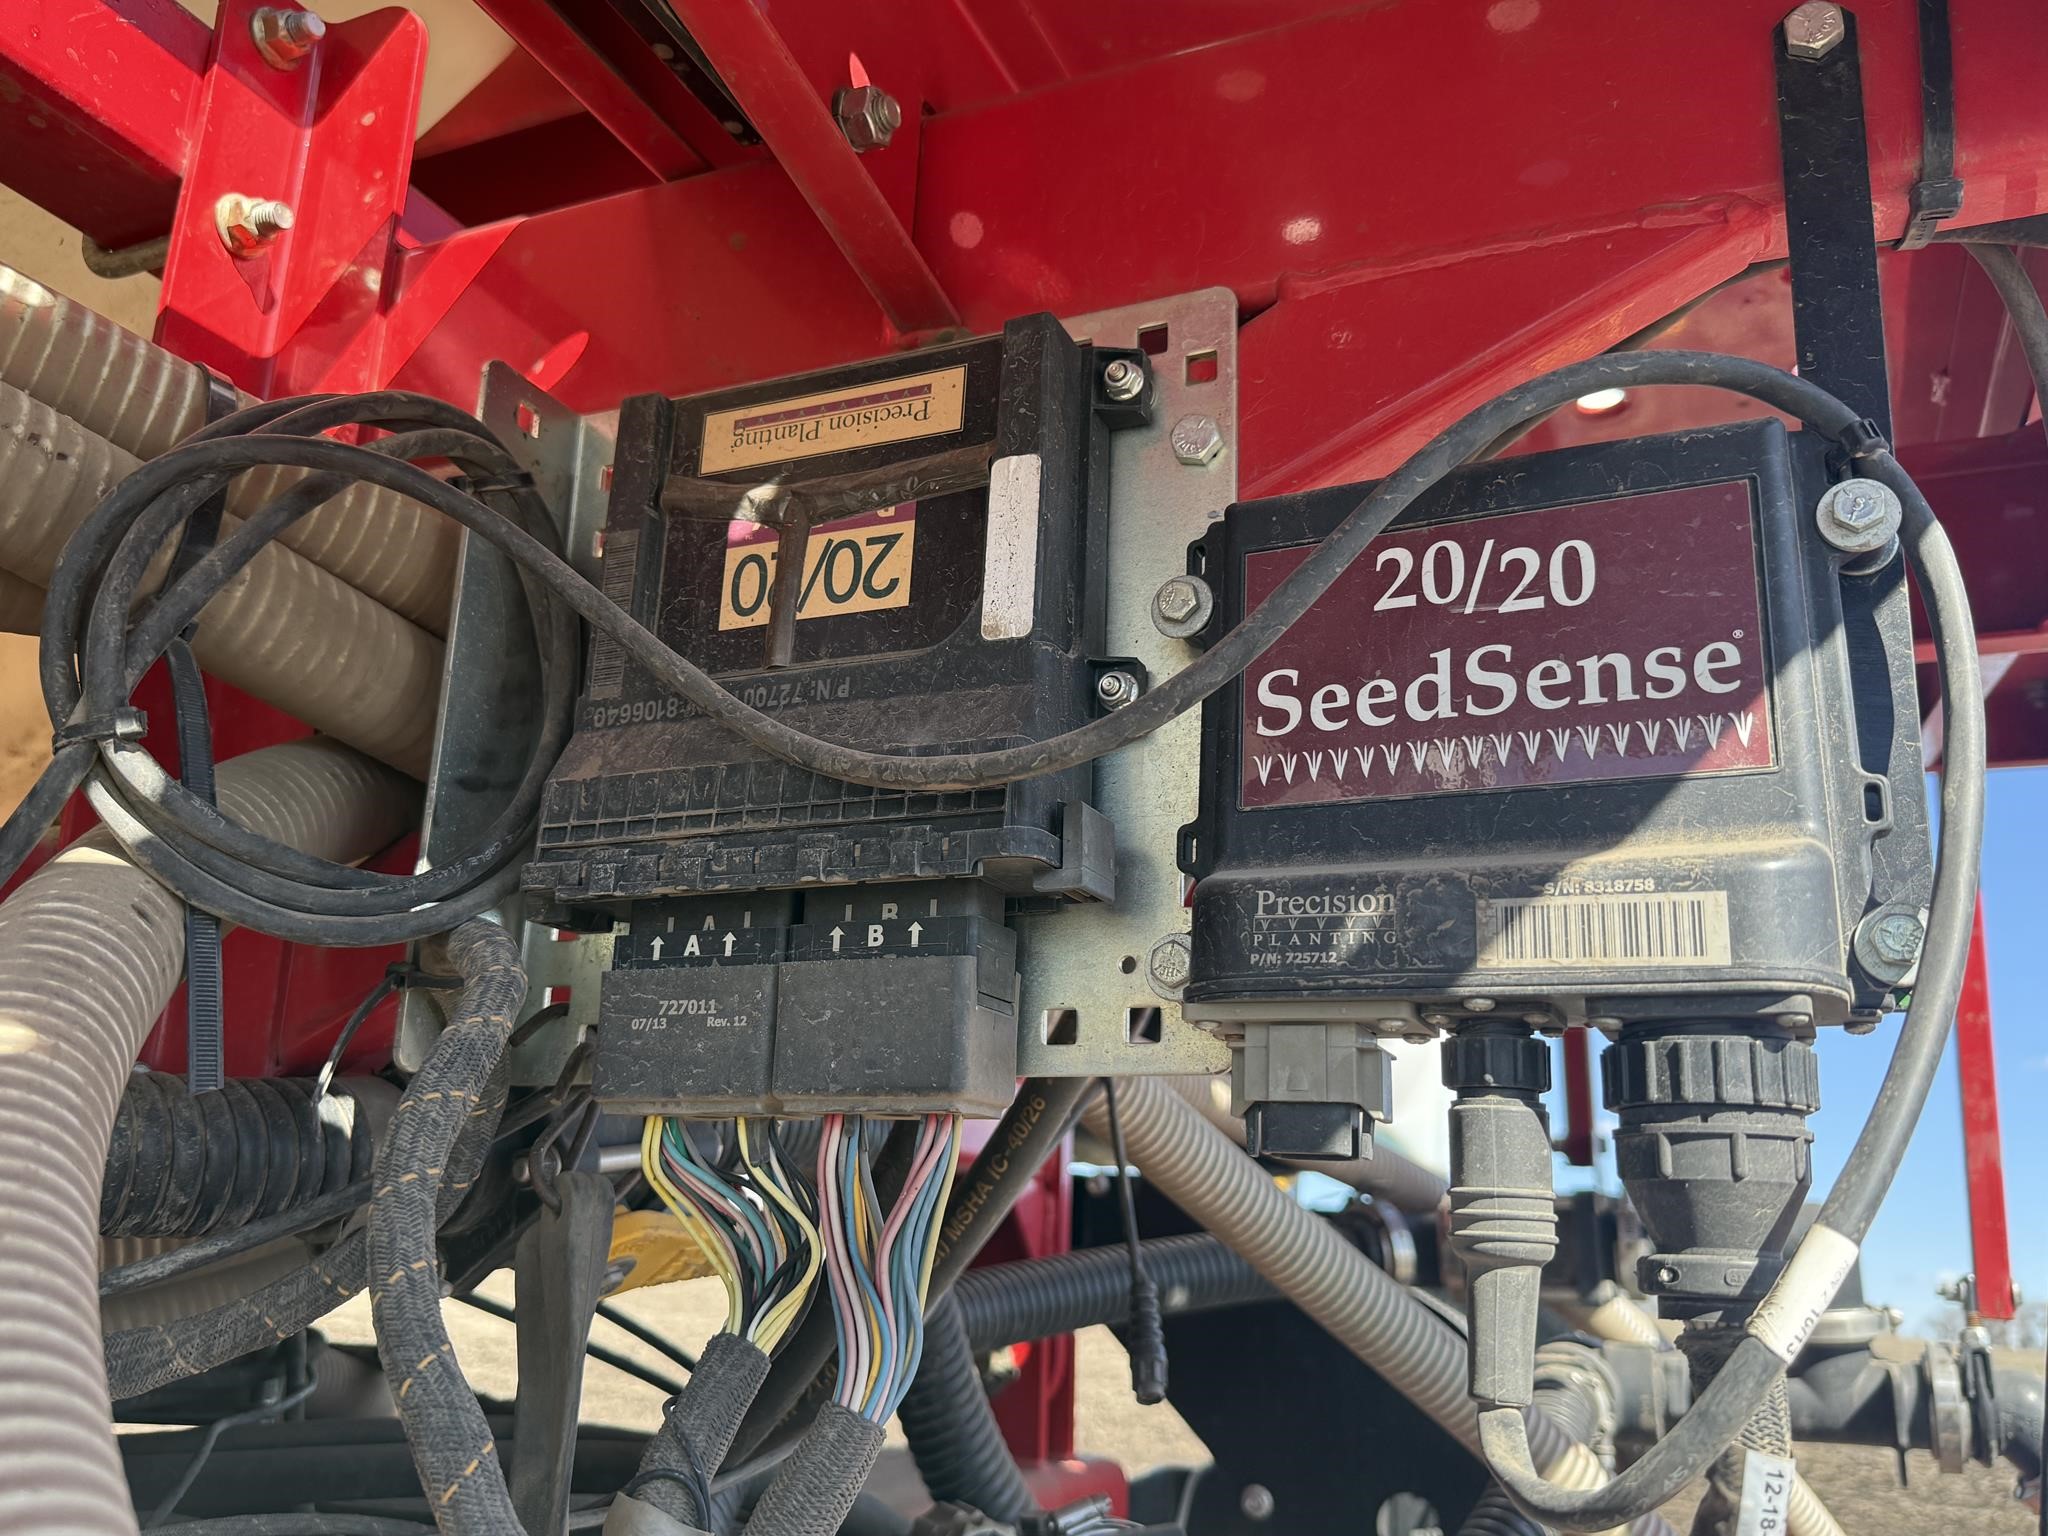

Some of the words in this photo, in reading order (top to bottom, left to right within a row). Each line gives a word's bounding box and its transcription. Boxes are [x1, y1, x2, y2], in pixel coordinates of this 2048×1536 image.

[829, 399, 931, 432] Precision
[732, 420, 821, 450] Planting
[731, 532, 904, 618] 20/0
[1373, 538, 1597, 614] 20/20
[810, 675, 851, 701] P/N:
[1256, 634, 1743, 738] SeedSense
[1543, 881, 1581, 896] S/N:
[1583, 878, 1656, 894] 8318758
[1255, 886, 1396, 915] Precision
[683, 934, 700, 956] A
[867, 924, 884, 947] B
[1252, 931, 1397, 946] PLANTING
[1250, 953, 1281, 966] P/N:
[1285, 951, 1338, 965] 725712
[658, 999, 718, 1016] 727011
[631, 1017, 668, 1032] 07/13
[706, 1016, 731, 1028] Rev.
[733, 1015, 748, 1027] 12
[943, 1179, 994, 1242] MSHA
[992, 1095, 1047, 1181] IC-40/26
